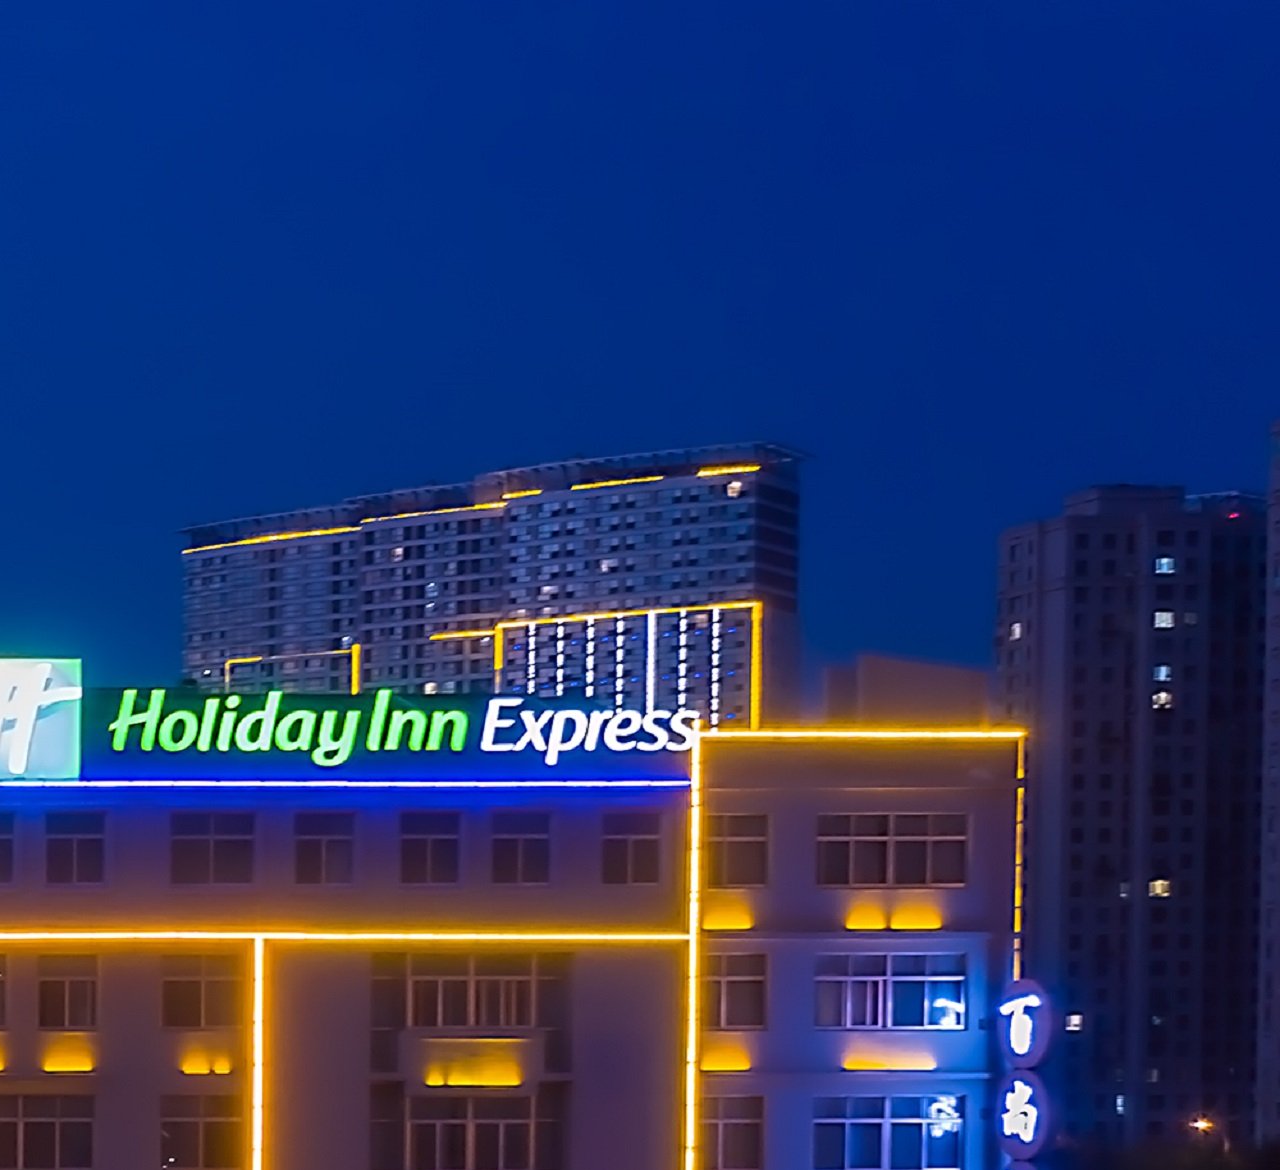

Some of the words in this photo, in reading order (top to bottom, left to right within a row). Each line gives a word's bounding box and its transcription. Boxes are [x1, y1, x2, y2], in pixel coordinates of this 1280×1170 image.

[109, 688, 359, 766] Holiday
[365, 688, 470, 753] Inn
[480, 697, 700, 766] Express
